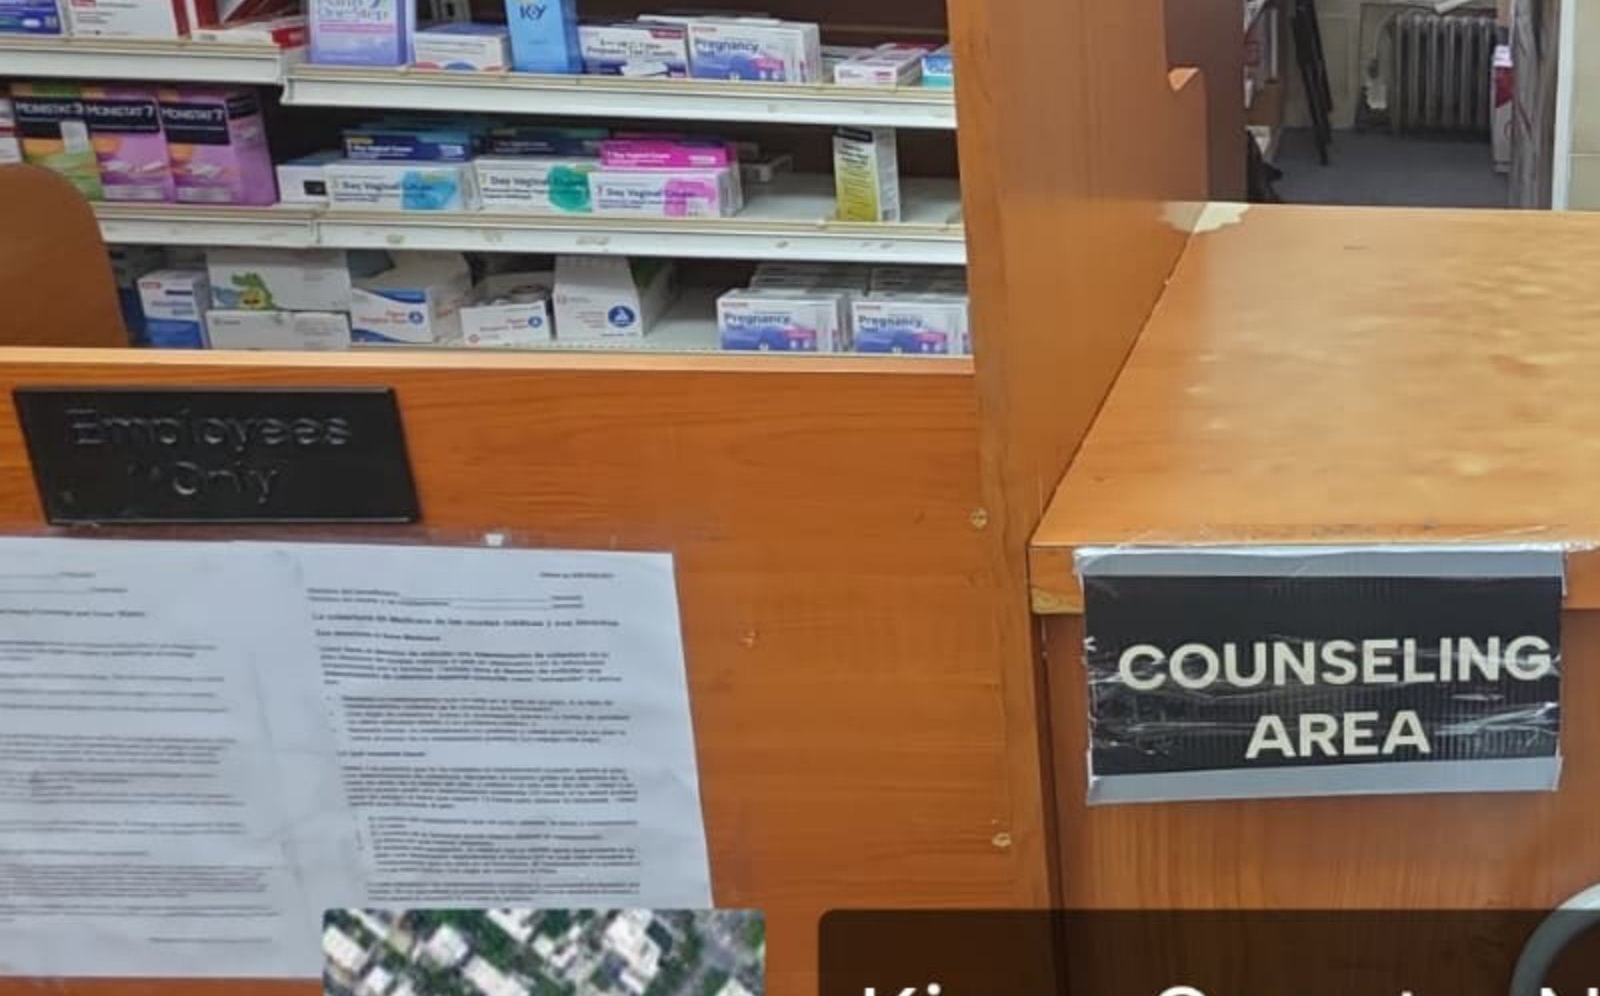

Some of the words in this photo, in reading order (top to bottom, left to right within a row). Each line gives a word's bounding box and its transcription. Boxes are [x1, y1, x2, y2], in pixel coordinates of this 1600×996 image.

[693, 37, 760, 56] Pregnancy
[722, 312, 792, 328] Pregnancy
[857, 314, 924, 330] Pregnancy
[1117, 635, 1553, 692] COUNSELING
[1244, 708, 1432, 760] AREA
